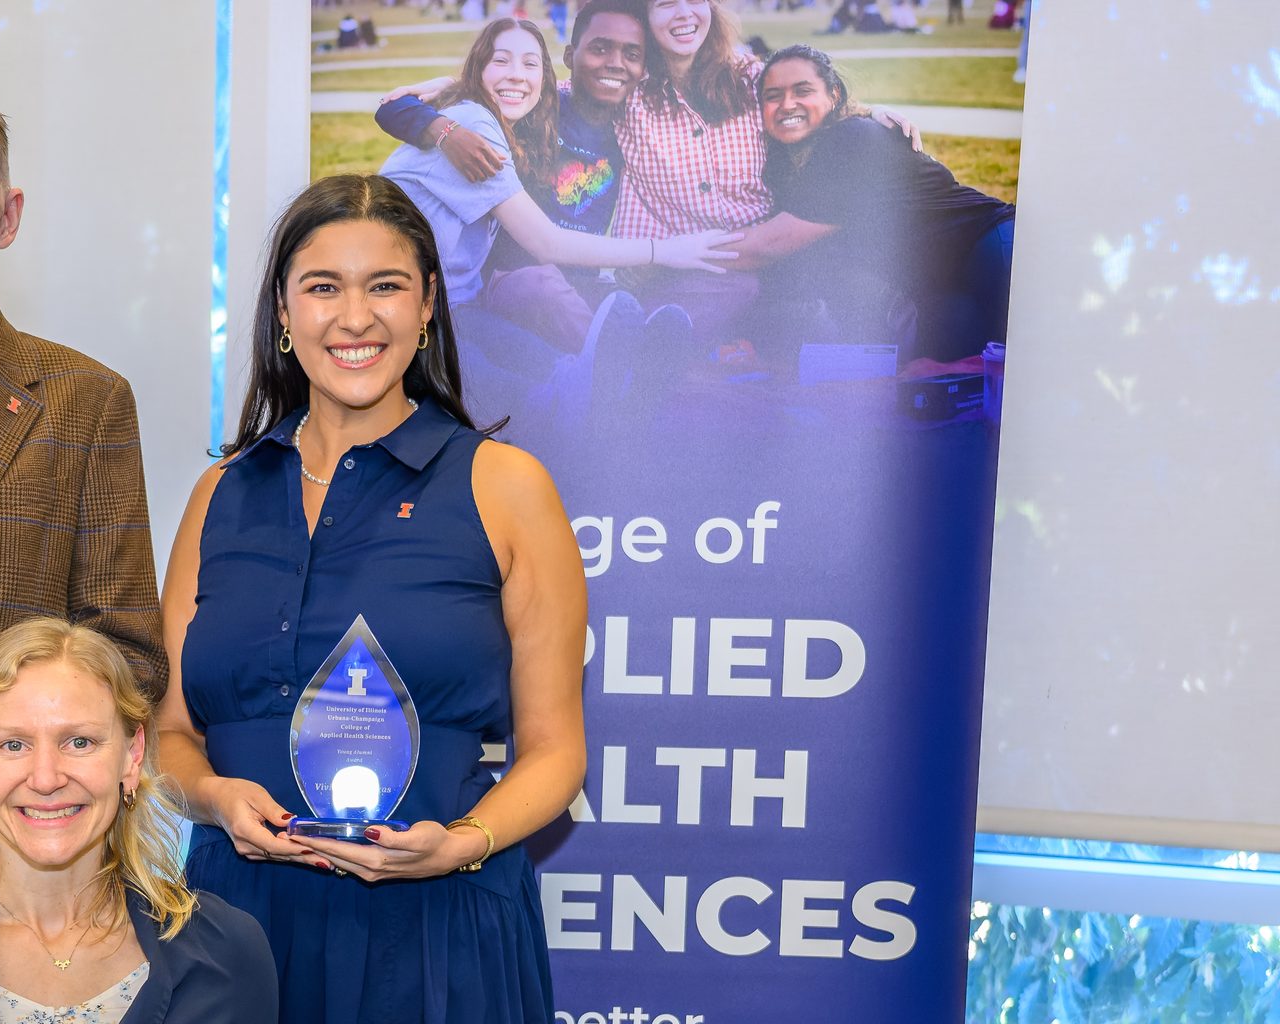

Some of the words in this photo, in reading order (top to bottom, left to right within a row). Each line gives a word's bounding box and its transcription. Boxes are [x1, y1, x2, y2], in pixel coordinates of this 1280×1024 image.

[570, 515, 668, 578] ge
[694, 501, 781, 564] of
[348, 668, 368, 696] I
[584, 616, 866, 698] LIED
[327, 714, 385, 722] Urbana-Champaign
[568, 745, 809, 829] LTH
[539, 872, 917, 962] ENCES
